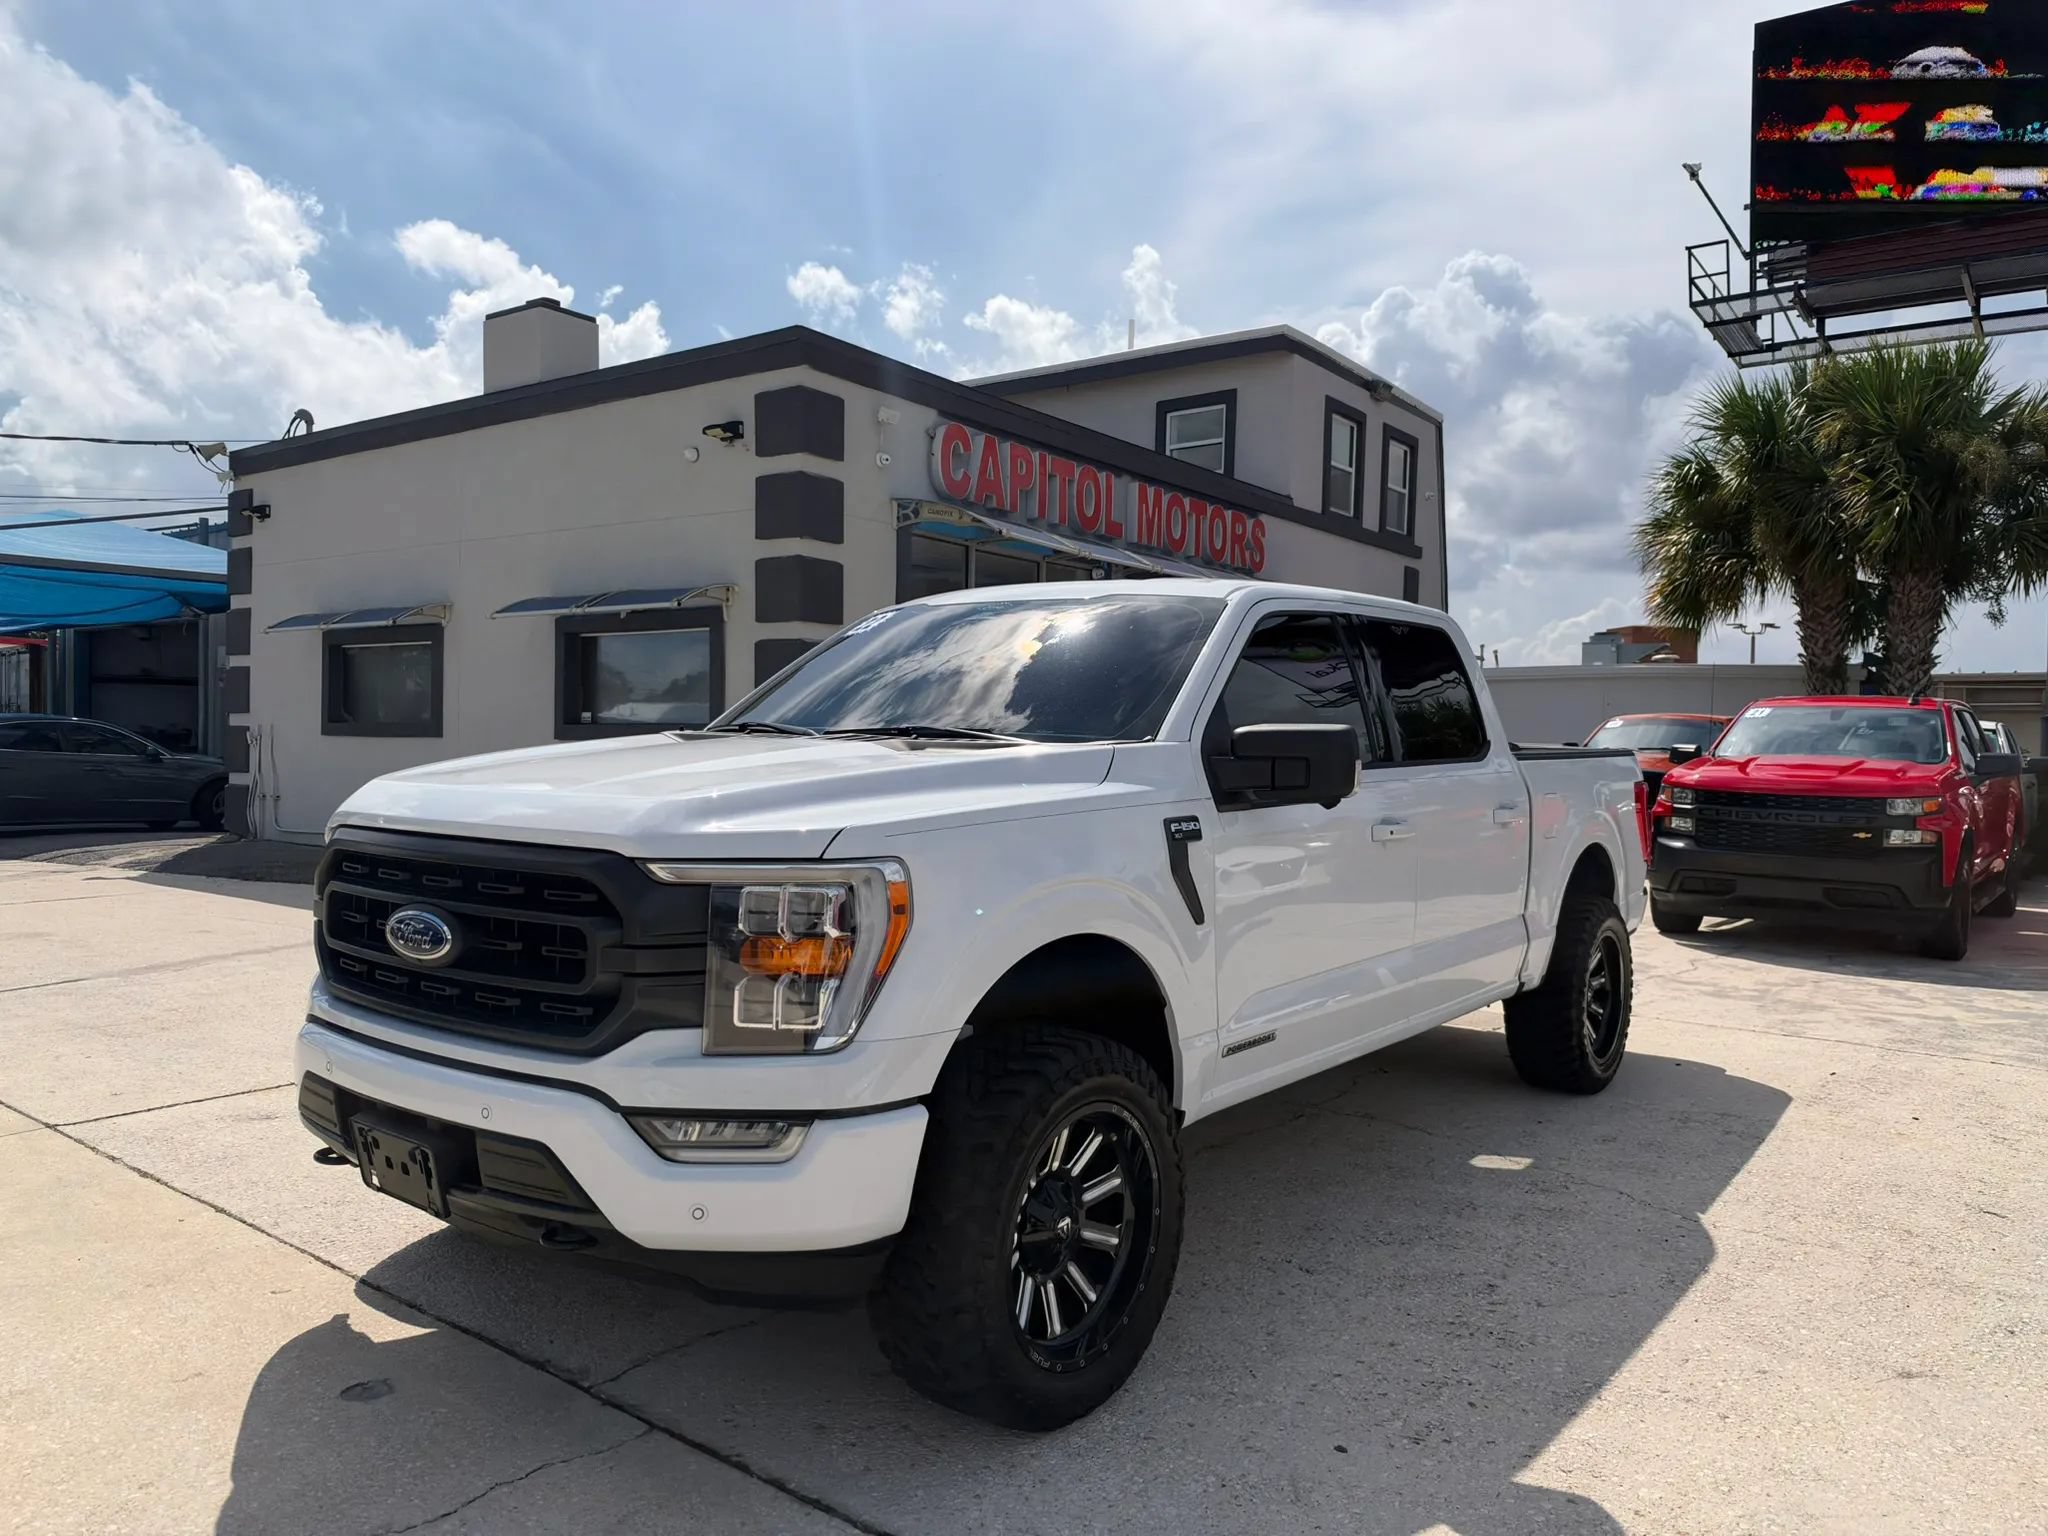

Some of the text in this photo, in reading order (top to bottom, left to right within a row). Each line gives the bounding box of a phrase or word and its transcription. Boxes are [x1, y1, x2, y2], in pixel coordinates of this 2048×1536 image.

[937, 421, 1266, 574] CAPITOL MOTORS
[1170, 821, 1201, 833] F-150
[1697, 806, 1878, 826] CHEVROLET
[393, 920, 433, 949] Ford
